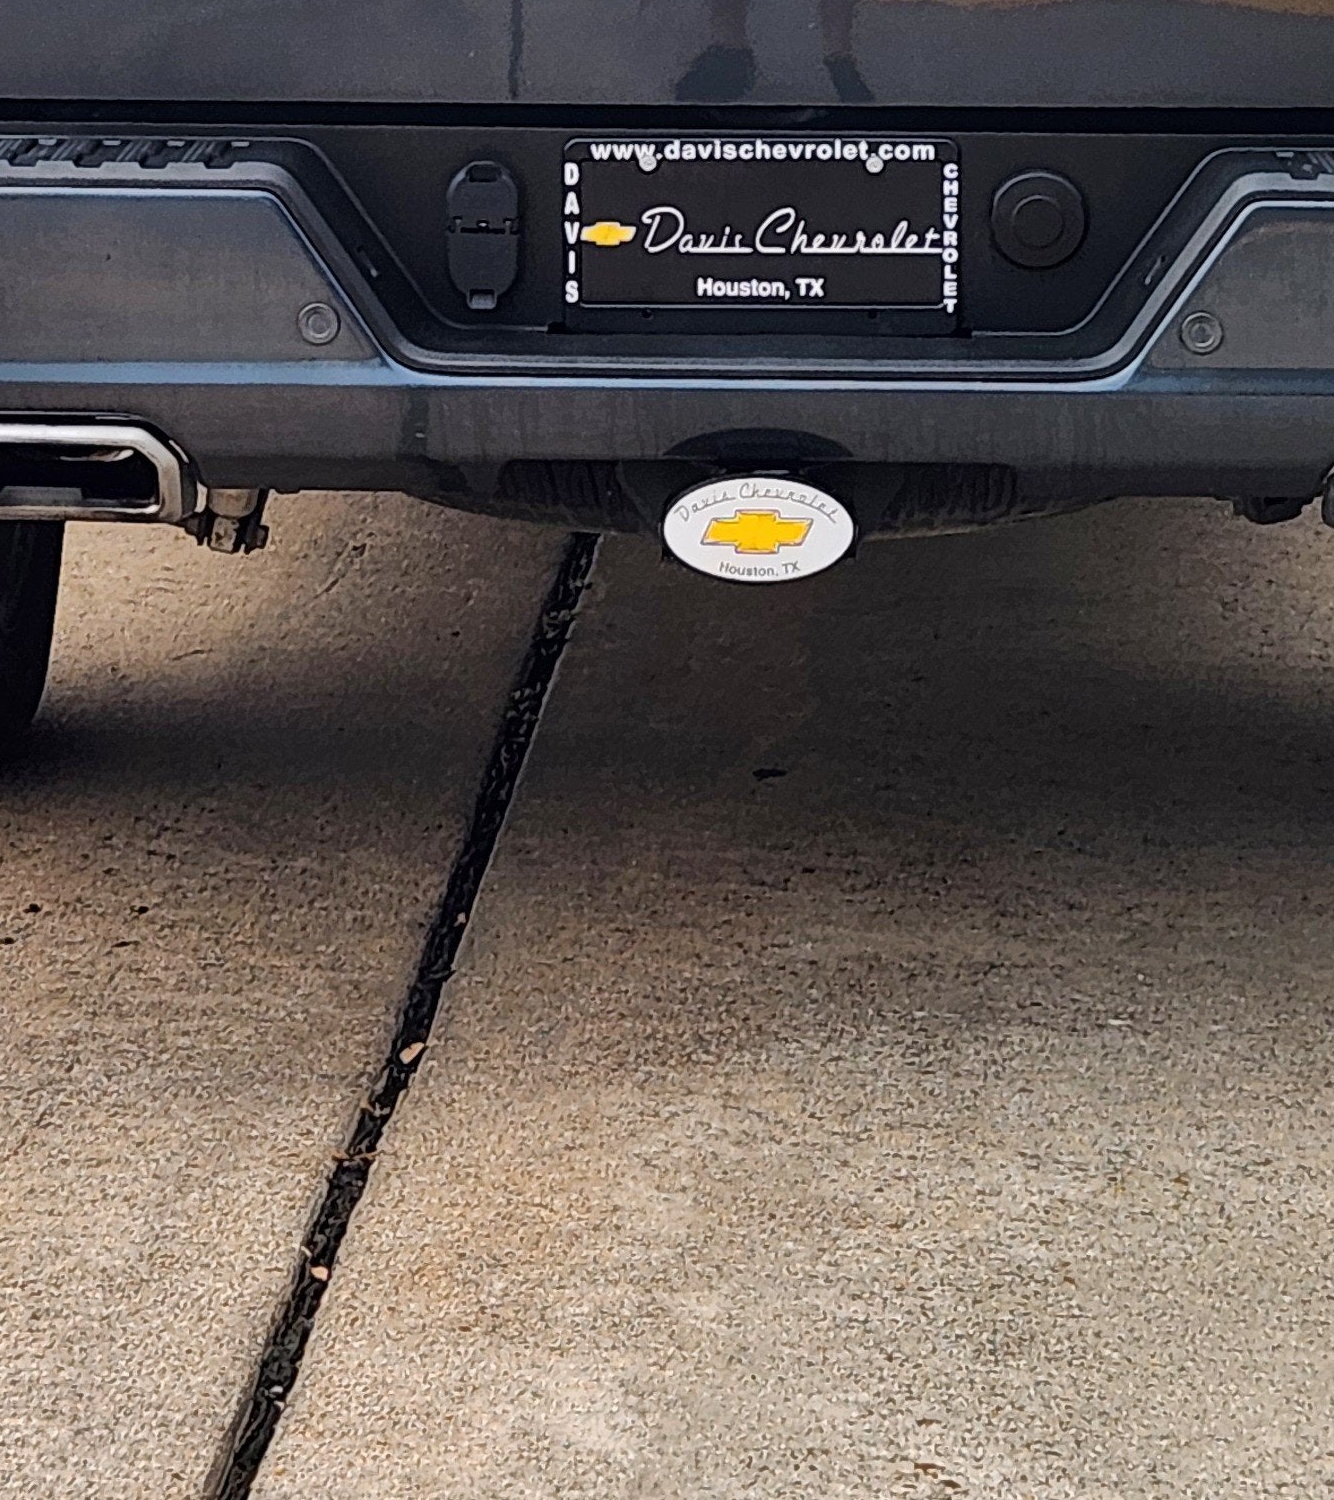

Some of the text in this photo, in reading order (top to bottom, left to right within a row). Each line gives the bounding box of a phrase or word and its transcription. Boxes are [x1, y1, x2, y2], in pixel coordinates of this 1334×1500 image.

[591, 139, 935, 161] www.davischevrolet.com
[564, 162, 580, 303] DAVIS
[641, 206, 942, 254] Davis Chevrolet
[942, 163, 959, 314] CHEVROLET
[697, 277, 825, 300] Houston, TX
[674, 482, 837, 524] Davis Chevrolet
[782, 560, 801, 572] TX
